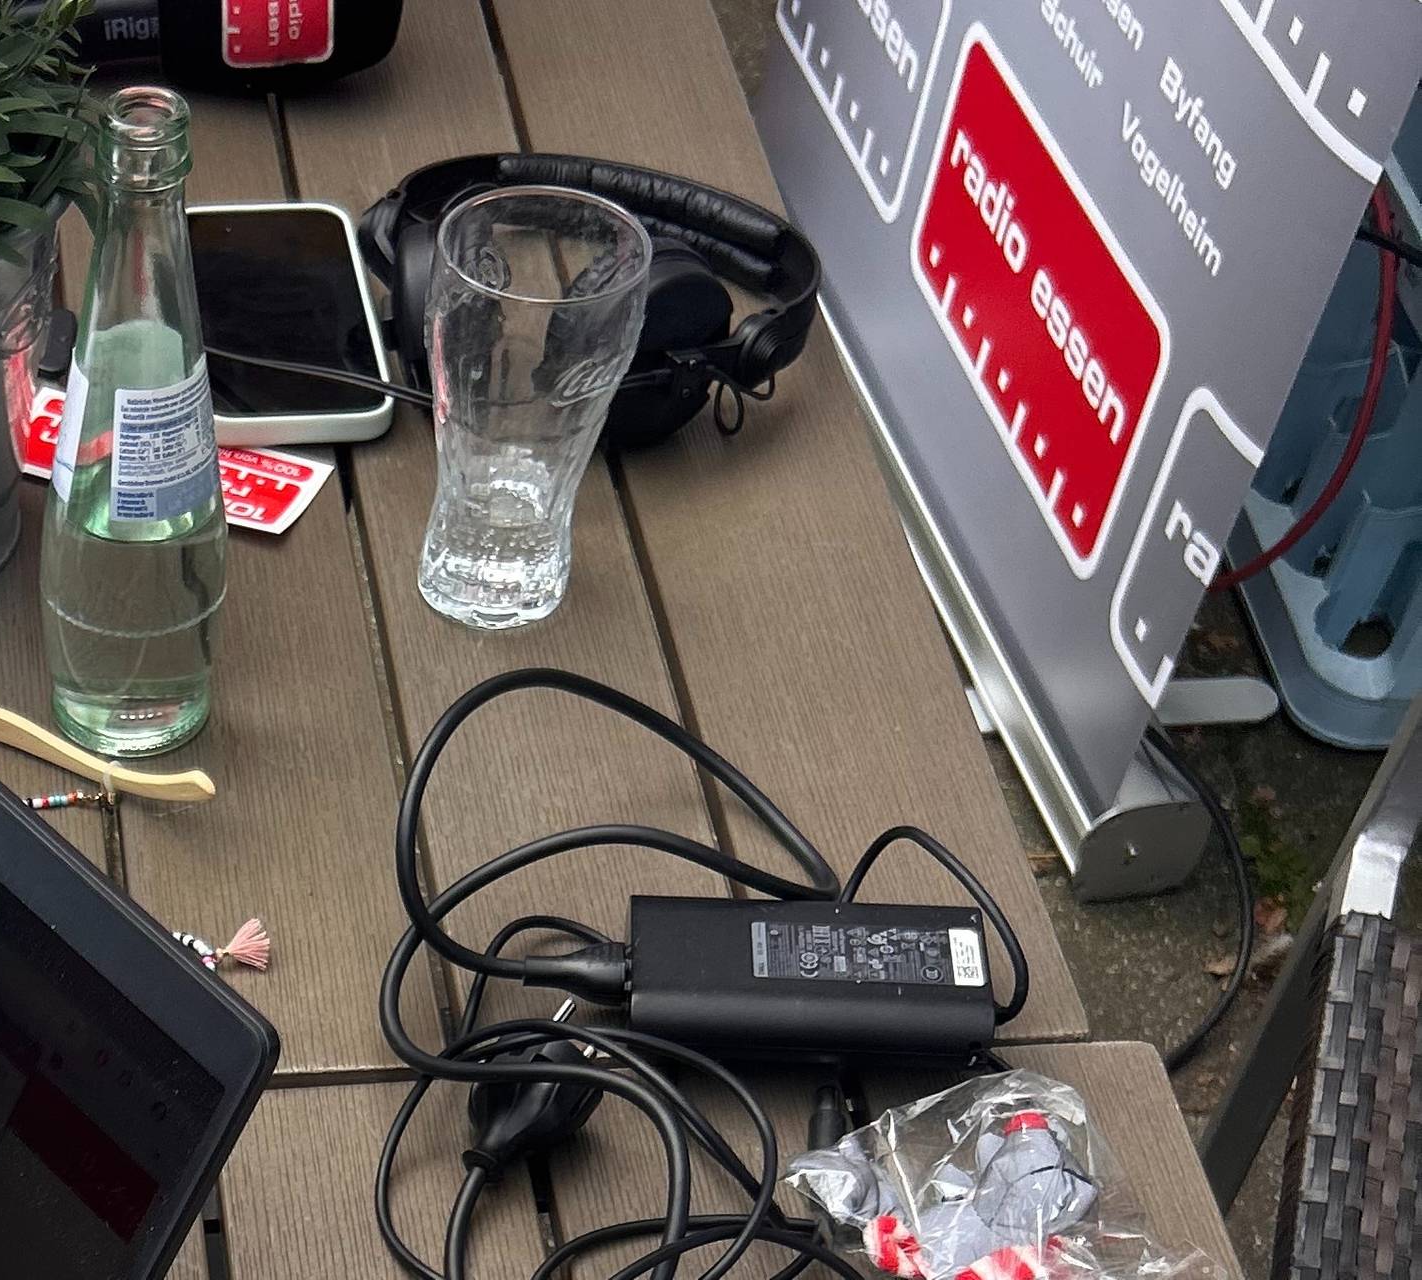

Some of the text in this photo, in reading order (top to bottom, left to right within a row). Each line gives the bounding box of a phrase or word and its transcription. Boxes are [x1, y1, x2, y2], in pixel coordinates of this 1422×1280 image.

[1122, 100, 1221, 277] Vogelheim
[1160, 56, 1237, 189] Byfang
[950, 128, 1127, 445] radio essen
